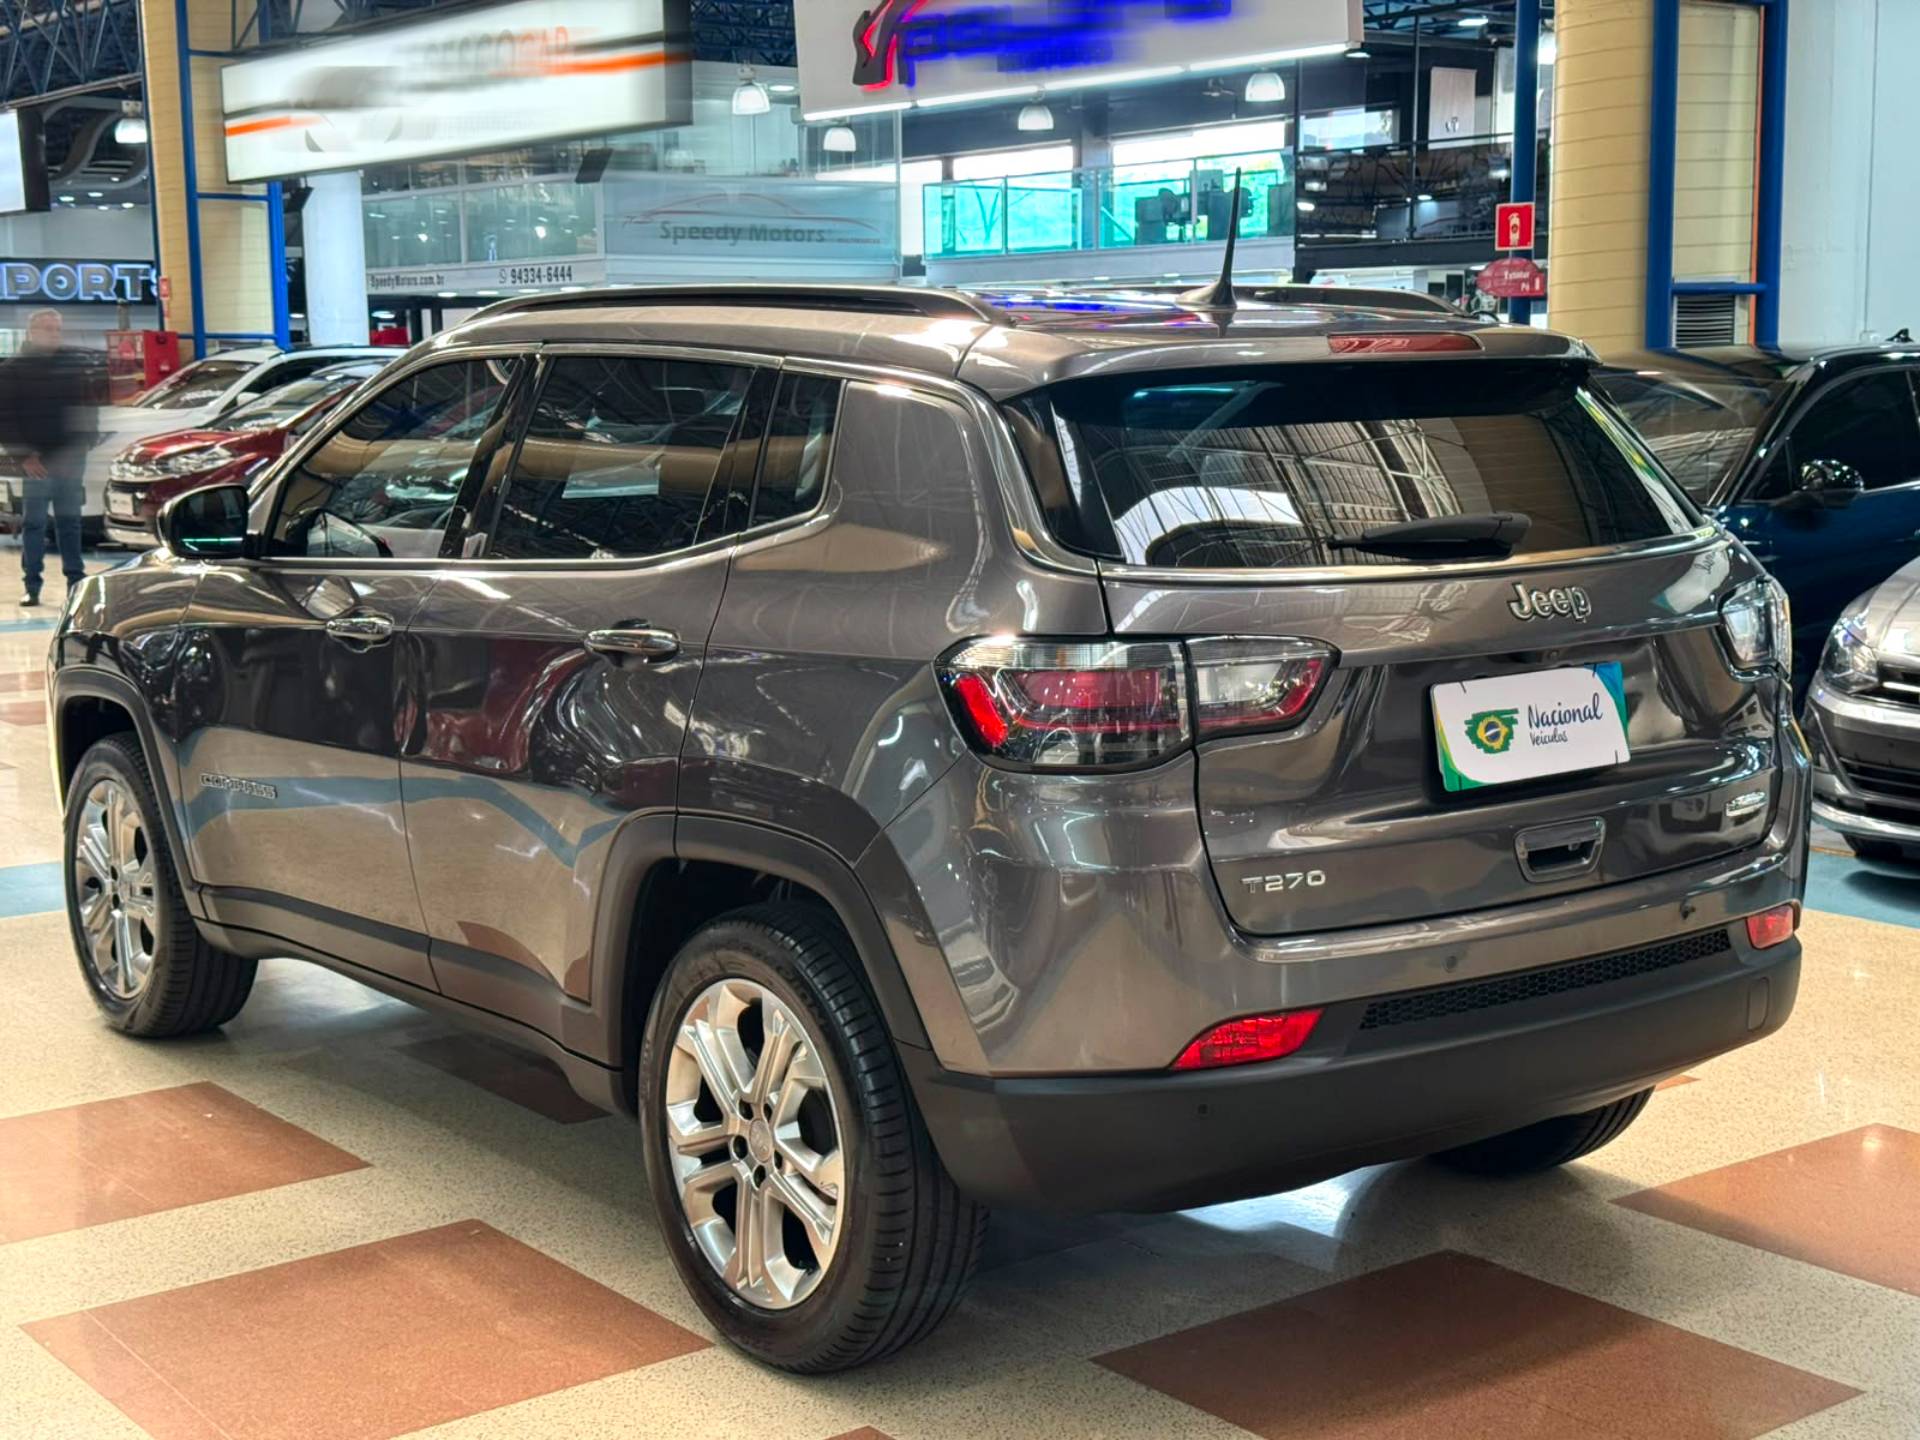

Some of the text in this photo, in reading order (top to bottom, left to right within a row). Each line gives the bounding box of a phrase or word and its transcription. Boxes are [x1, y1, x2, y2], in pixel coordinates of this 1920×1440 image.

[660, 221, 826, 246] Speedy Motors
[511, 265, 573, 285] 94334-6444
[1508, 583, 1592, 621] Jeep
[1528, 693, 1604, 729] Nacional
[1241, 870, 1326, 894] T270
